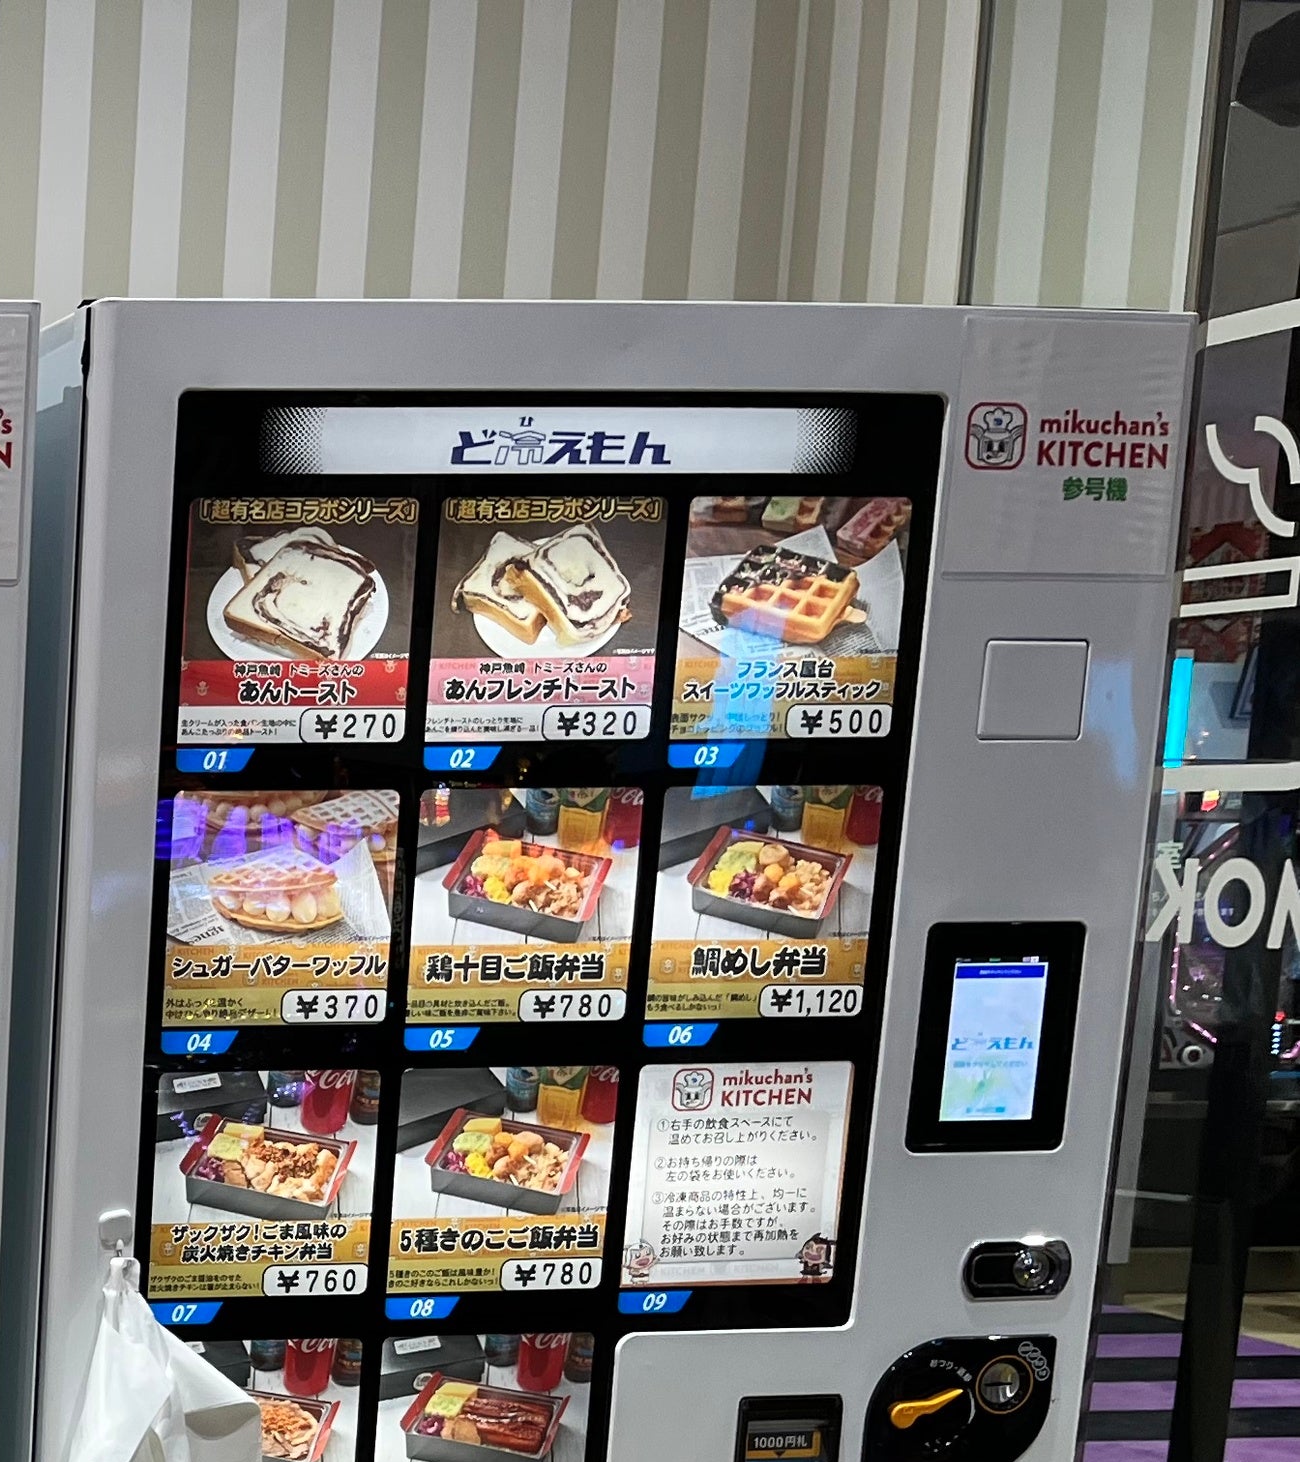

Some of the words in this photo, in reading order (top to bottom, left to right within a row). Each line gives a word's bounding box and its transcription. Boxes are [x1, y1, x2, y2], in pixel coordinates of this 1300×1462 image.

[1040, 410, 1170, 438] mikuchan's
[1037, 440, 1169, 470] KITCHEN
[1062, 476, 1128, 502] 参号機
[290, 664, 364, 677] トミーズさんの
[534, 662, 607, 673] トミーズさんの
[738, 660, 834, 679] フランス屋台
[239, 680, 356, 703] あんトースト
[446, 677, 635, 700] あんフレンチトースト
[683, 682, 881, 700] スイーツワッフルスティック
[315, 713, 396, 739] ¥270
[558, 711, 636, 736] ¥320
[801, 709, 882, 734] ¥500
[203, 751, 227, 770] 01
[172, 955, 387, 978] シュガーバターワッフル
[427, 954, 604, 982] 鶏十目ご飯弁当
[692, 947, 826, 977] 鯛めし弁当
[296, 995, 378, 1019] ¥370
[533, 994, 611, 1019] ¥780
[400, 1226, 599, 1252] 5種きのこご飯弁当
[182, 1243, 332, 1263] 炭火焼きチキン弁当
[278, 1269, 356, 1293] ¥760
[515, 1262, 592, 1286] ¥780
[753, 1435, 808, 1449] 1000円札
